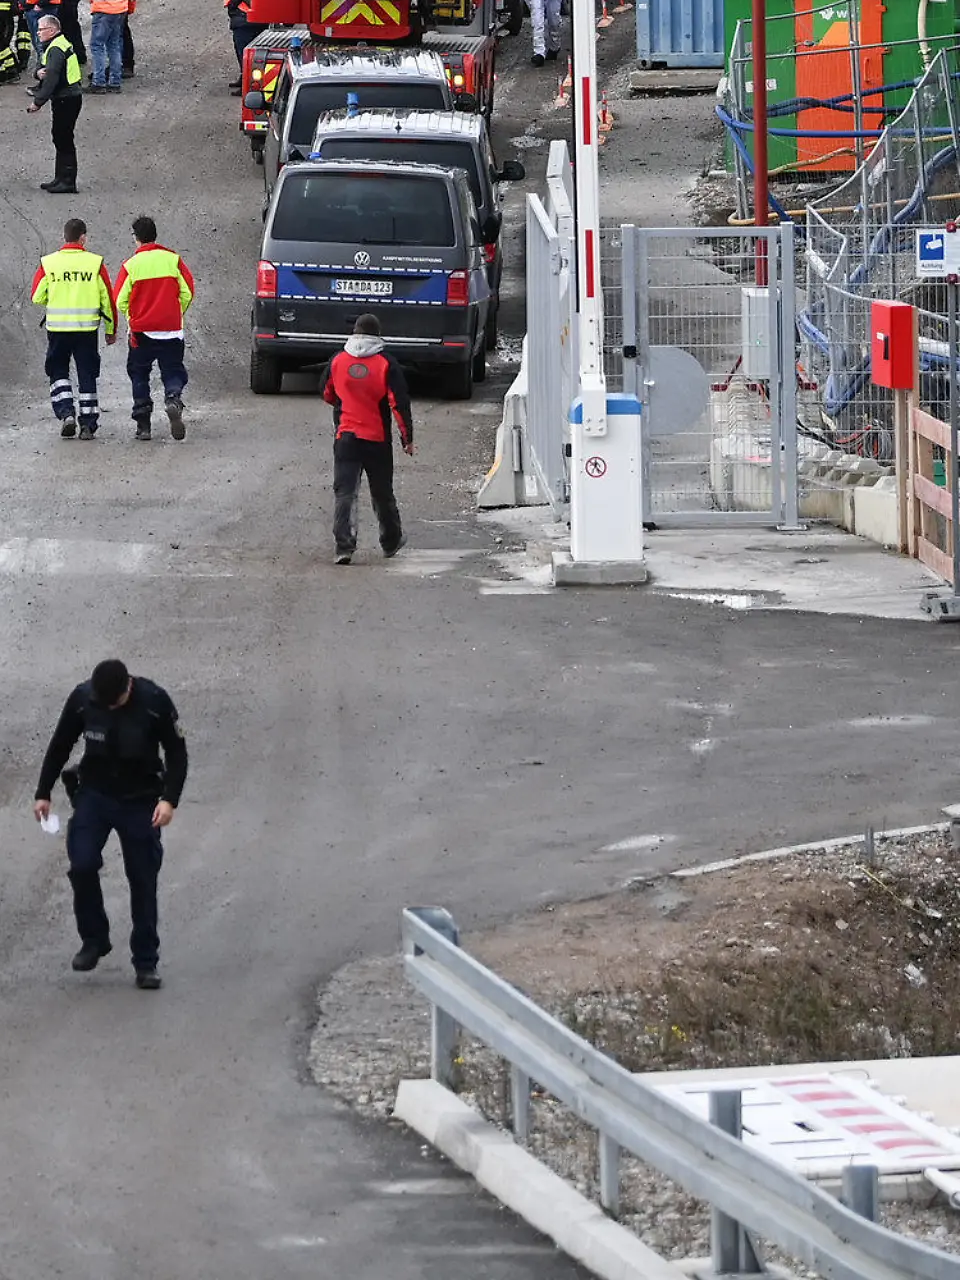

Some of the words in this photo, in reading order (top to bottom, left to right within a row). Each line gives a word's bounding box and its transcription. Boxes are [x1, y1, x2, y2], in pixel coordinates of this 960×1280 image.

[50, 272, 60, 282] 1.
[63, 271, 93, 282] RTW
[336, 279, 354, 291] STA
[360, 280, 372, 292] DA
[373, 281, 392, 293] 123
